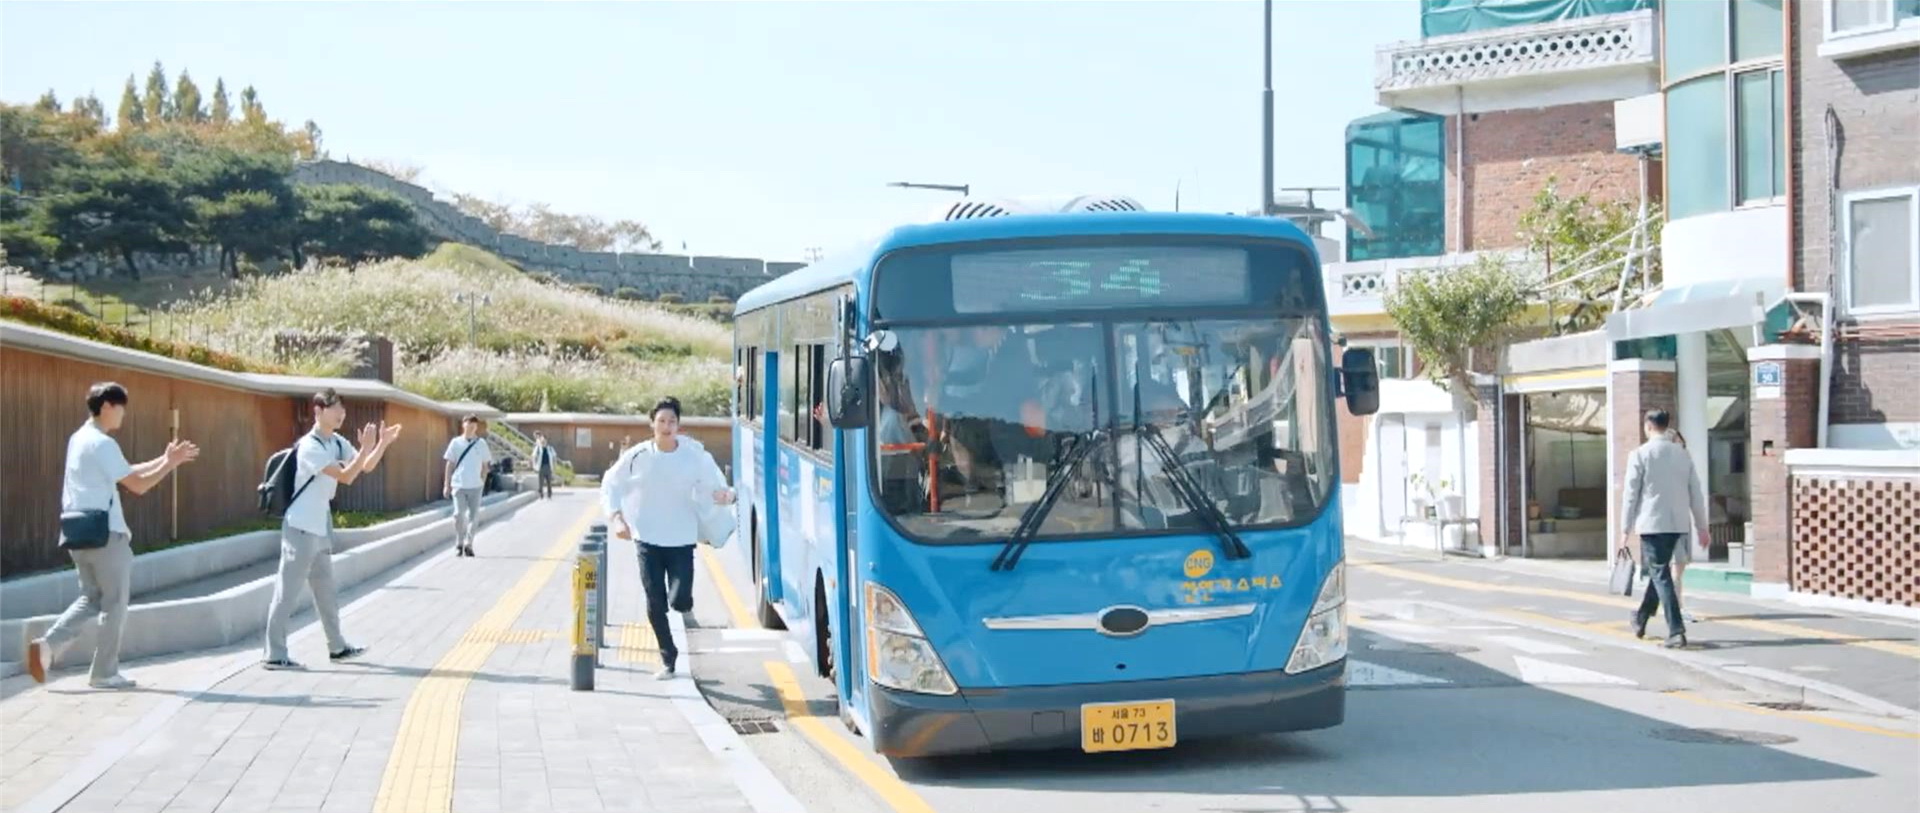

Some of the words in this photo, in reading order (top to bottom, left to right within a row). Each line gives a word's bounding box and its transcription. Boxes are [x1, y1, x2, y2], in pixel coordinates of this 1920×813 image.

[1185, 556, 1211, 570] CNG
[1111, 708, 1129, 719] 서울
[1132, 707, 1146, 718] 73
[1092, 726, 1105, 745] 바
[1112, 721, 1169, 745] 0713
